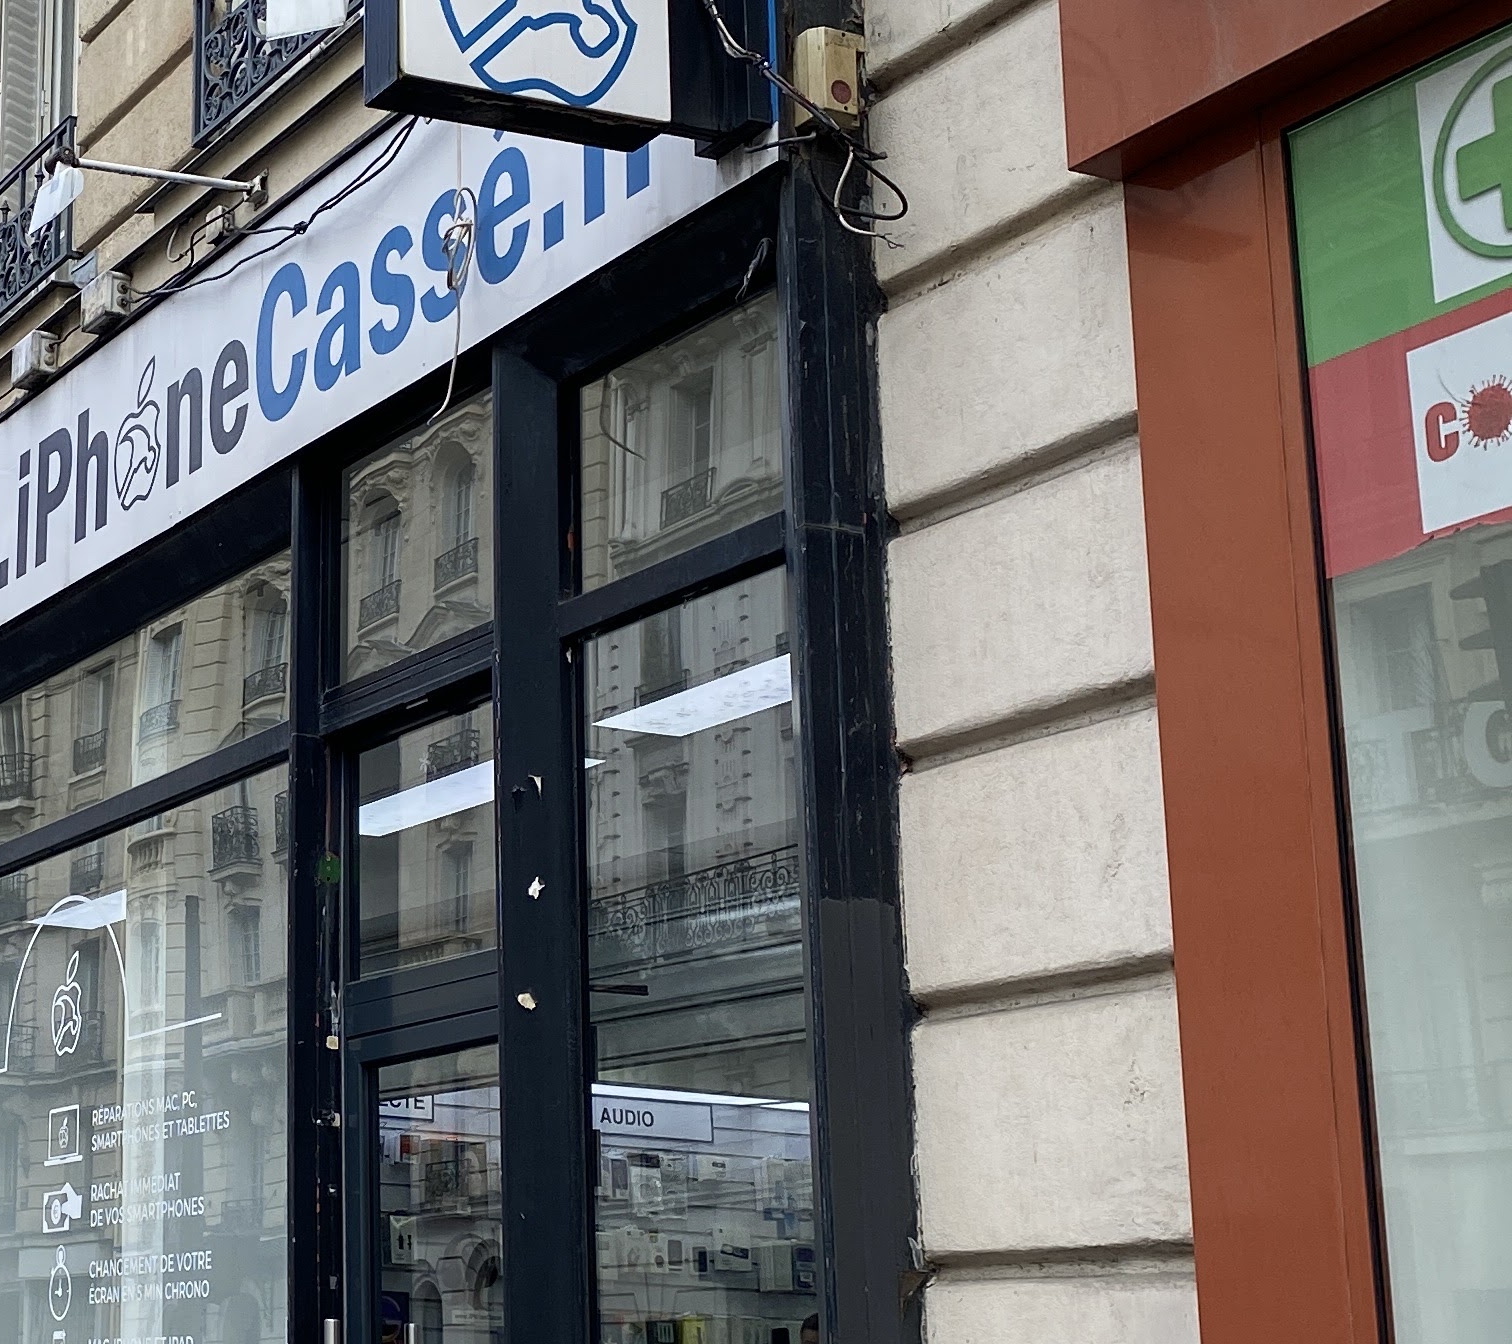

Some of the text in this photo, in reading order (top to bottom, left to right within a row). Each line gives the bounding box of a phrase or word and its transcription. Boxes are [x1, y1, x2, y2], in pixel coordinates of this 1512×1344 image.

[91, 1098, 155, 1126] RÉPARATIONS
[600, 1107, 654, 1127] AUDIO
[91, 1110, 230, 1151] SMARTPHONES ET TABLETTES
[90, 1179, 127, 1202] RACHAT
[90, 1196, 205, 1228] DE VOS SMARTPHONES
[88, 1250, 212, 1278] CHANGEMENT DE VOTRE
[89, 1282, 120, 1305] ÉCRAN
[121, 1285, 135, 1303] EN
[144, 1282, 162, 1301] MIN
[164, 1279, 210, 1301] CHRONO
